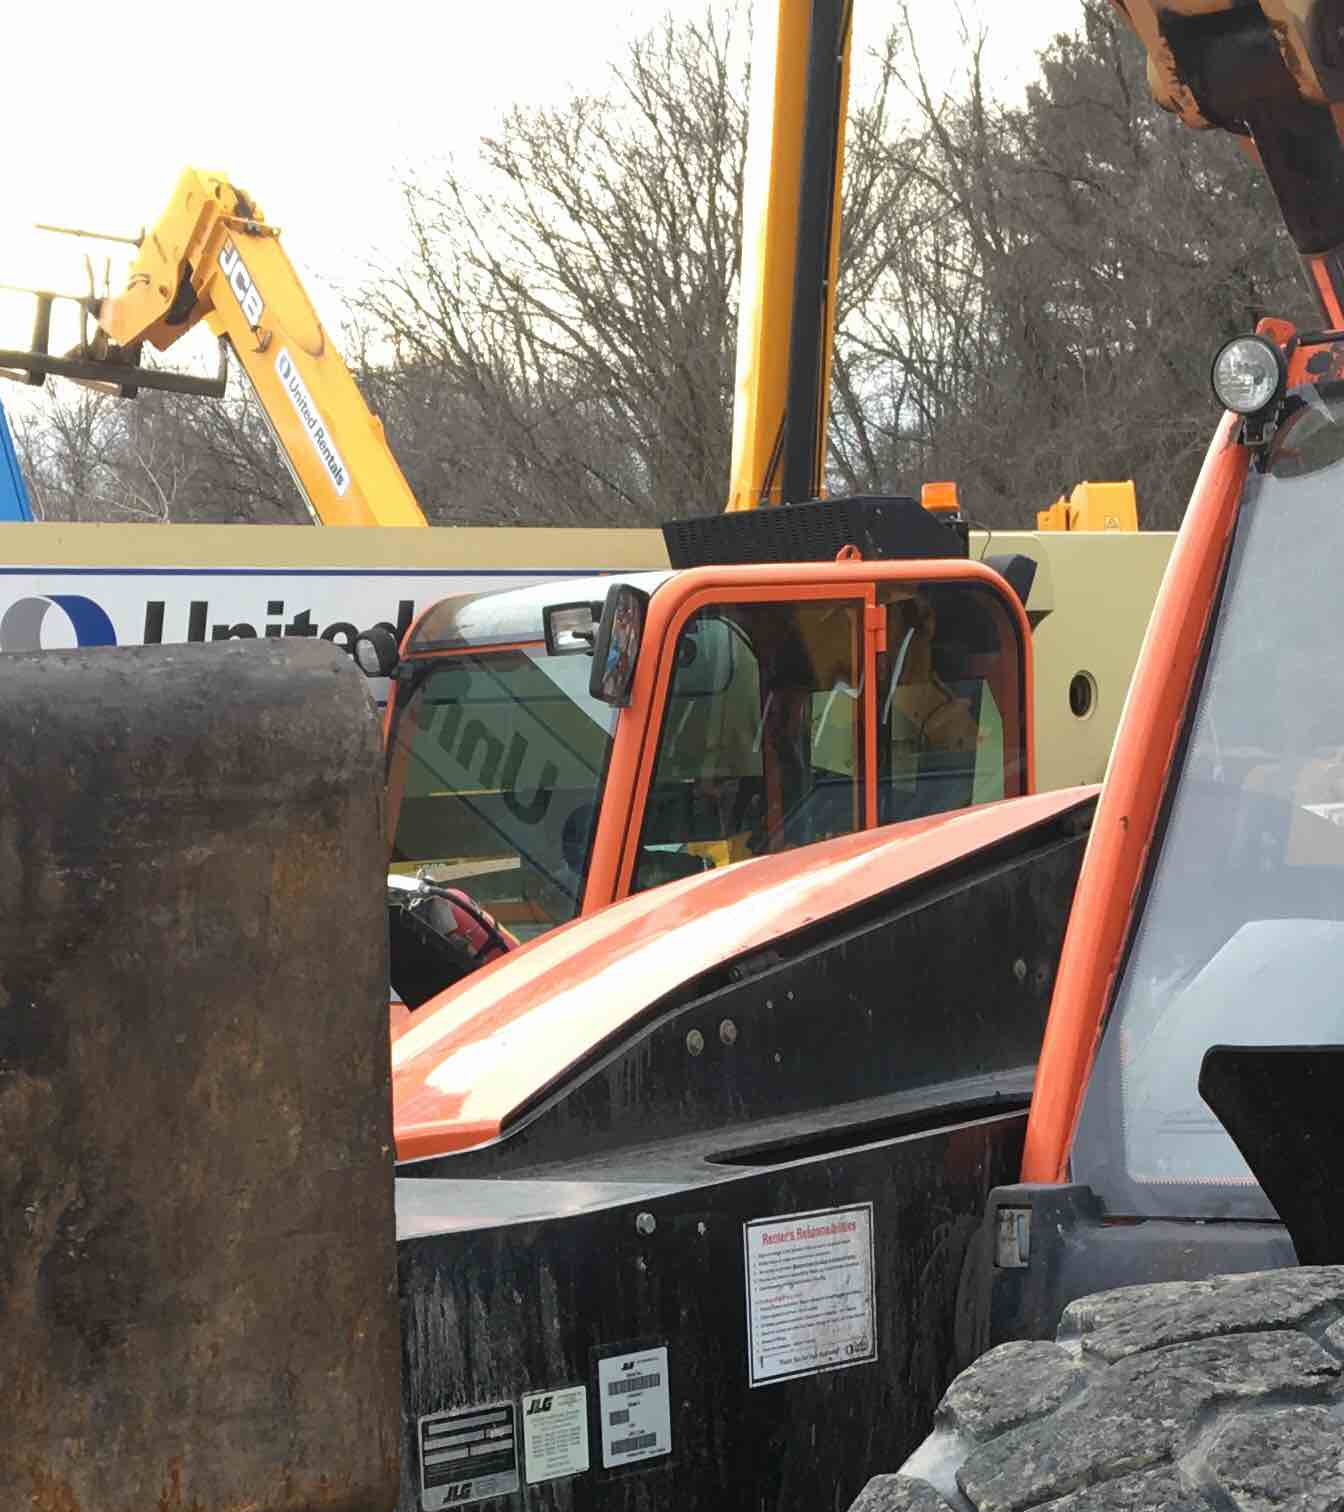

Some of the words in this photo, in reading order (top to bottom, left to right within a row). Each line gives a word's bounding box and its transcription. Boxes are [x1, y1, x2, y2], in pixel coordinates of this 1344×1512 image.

[218, 238, 265, 329] JCB
[289, 376, 316, 430] United
[312, 427, 345, 487] Rentals
[527, 1396, 553, 1416] JLG
[443, 1482, 472, 1504] JLG
